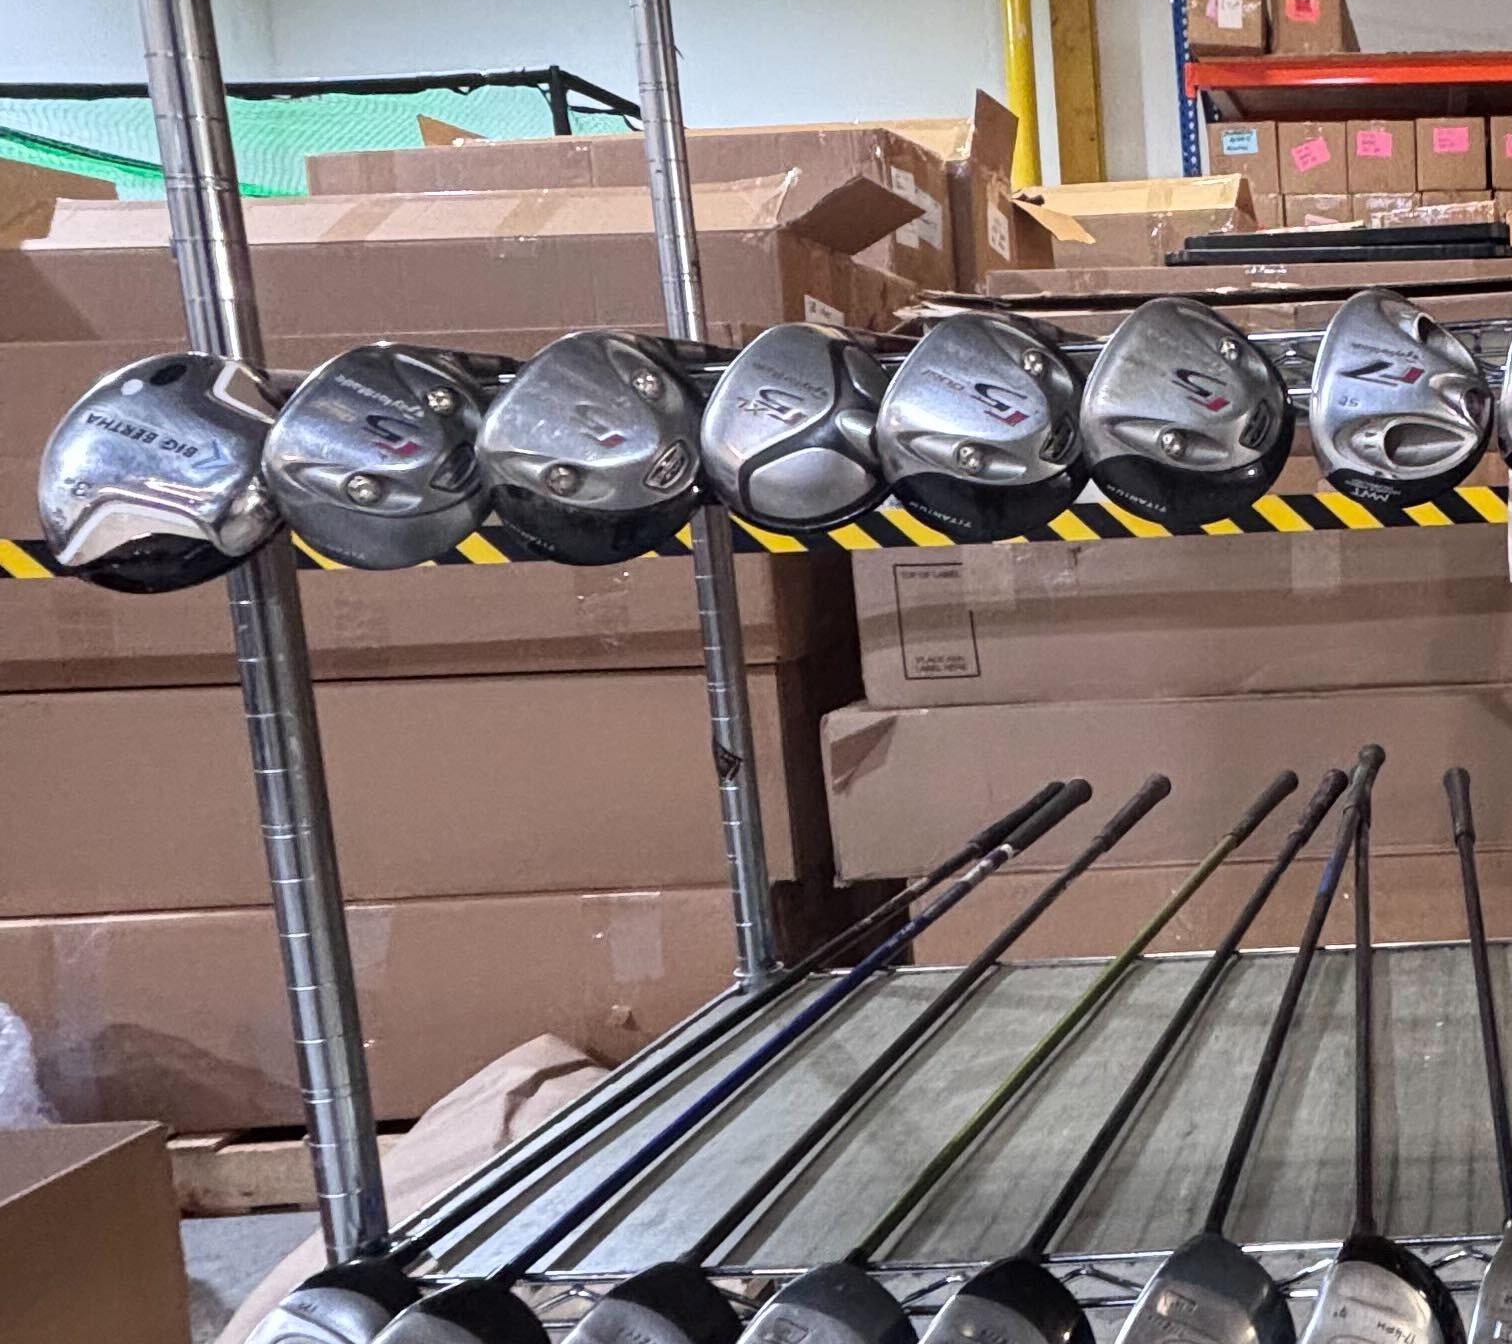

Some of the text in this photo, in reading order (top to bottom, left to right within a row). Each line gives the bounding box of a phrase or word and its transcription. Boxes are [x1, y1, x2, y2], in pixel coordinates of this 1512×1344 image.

[334, 374, 425, 420] TaylorMade
[84, 412, 199, 459] BIG BERTHA
[908, 498, 973, 529] TITANIUM
[1105, 483, 1168, 513] TITANIUM
